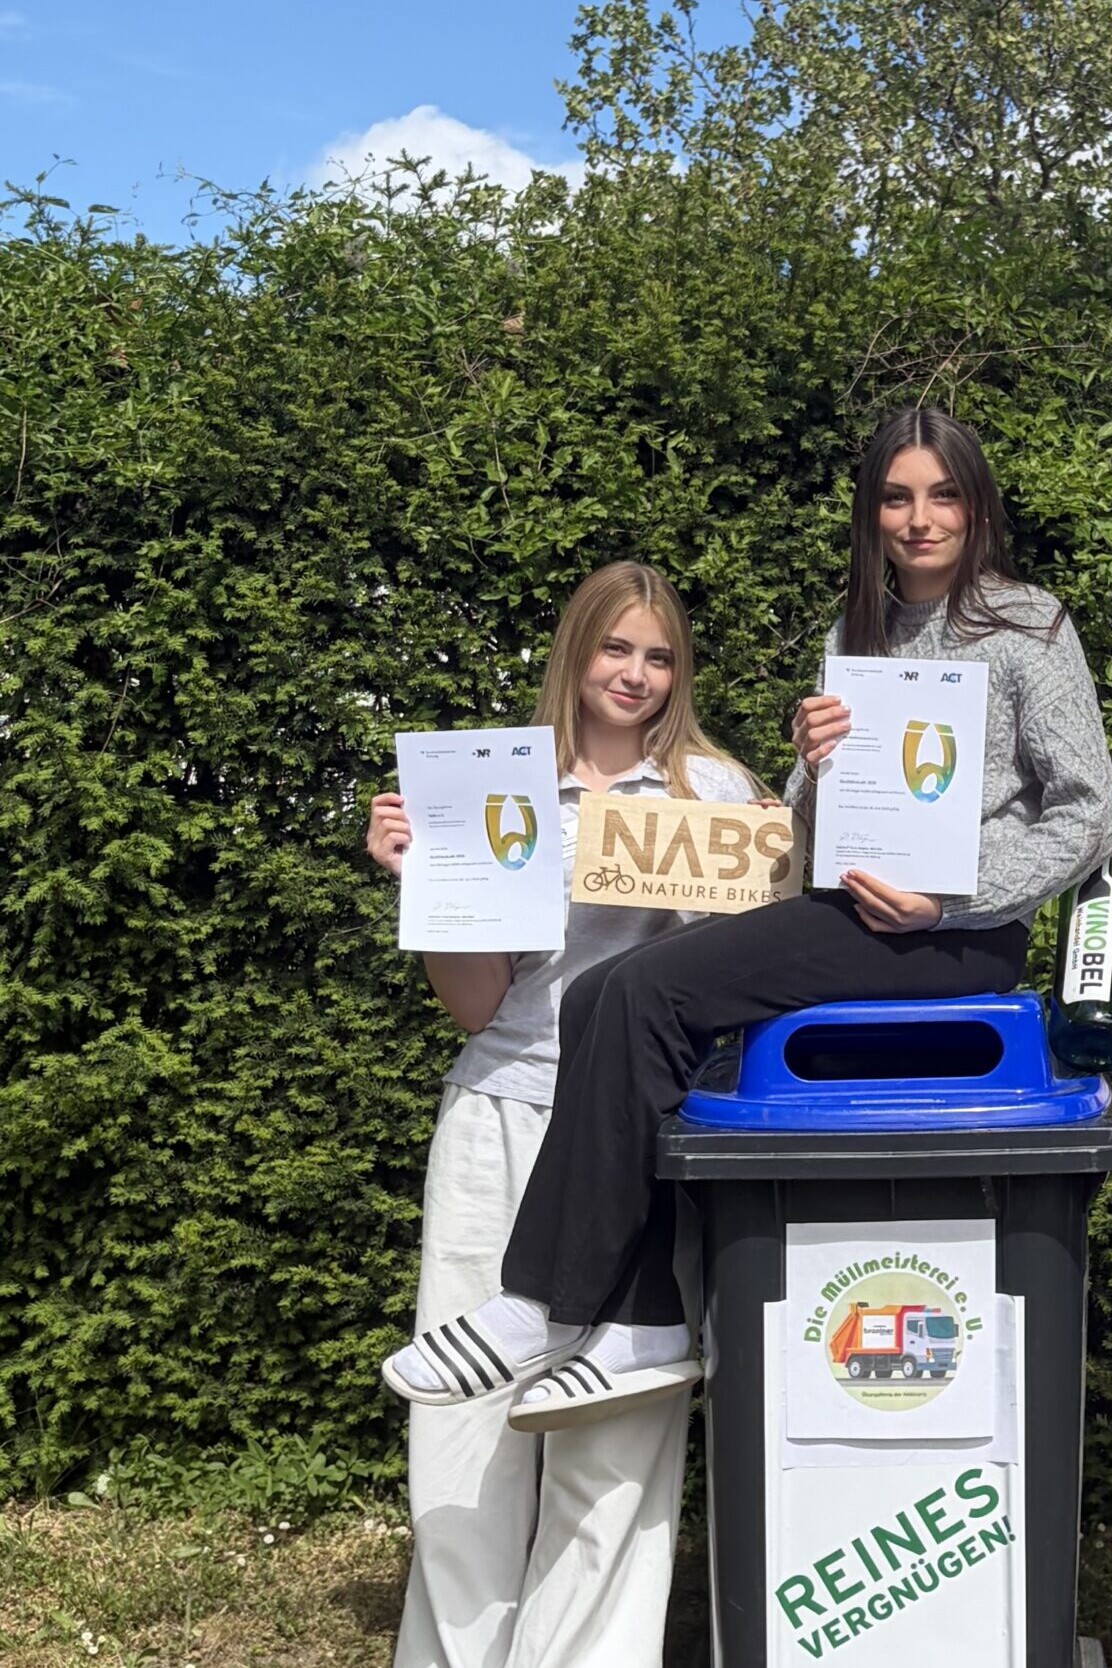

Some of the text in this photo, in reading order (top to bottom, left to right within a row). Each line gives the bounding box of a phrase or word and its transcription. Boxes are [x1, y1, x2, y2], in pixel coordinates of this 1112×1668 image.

[941, 673, 963, 683] ACT
[512, 746, 532, 756] ACT
[602, 809, 794, 883] NABS
[642, 881, 781, 903] NATURE BIKES
[1079, 899, 1110, 994] VINOBEL
[804, 1306, 827, 1343] Die
[821, 1252, 959, 1302] Müllmeisterei
[775, 1469, 1000, 1629] REINES
[797, 1515, 1016, 1659] VERGNÜGEN!
